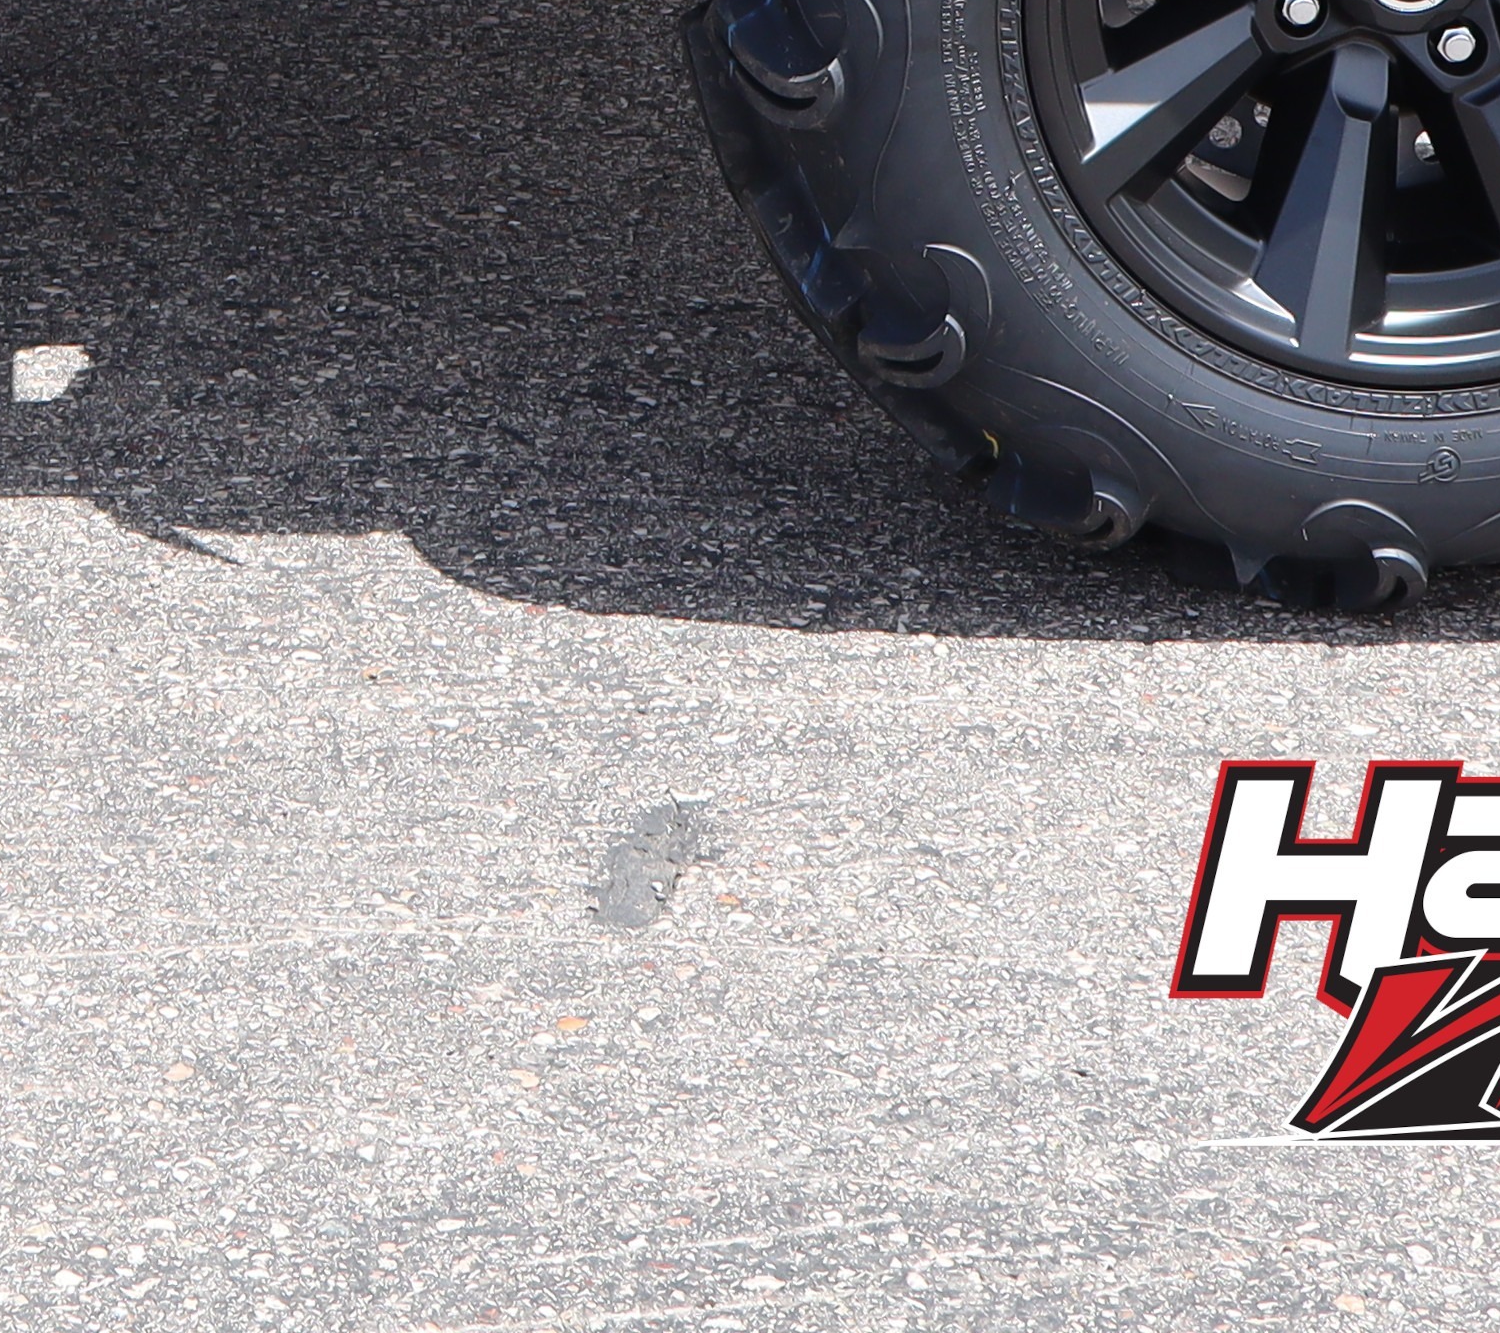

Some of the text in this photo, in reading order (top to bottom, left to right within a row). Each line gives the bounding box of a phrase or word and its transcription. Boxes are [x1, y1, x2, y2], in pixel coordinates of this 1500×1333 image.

[1216, 414, 1283, 453] ROTATION
[1382, 427, 1426, 443] TAIWAN
[1451, 427, 1483, 442] MADE
